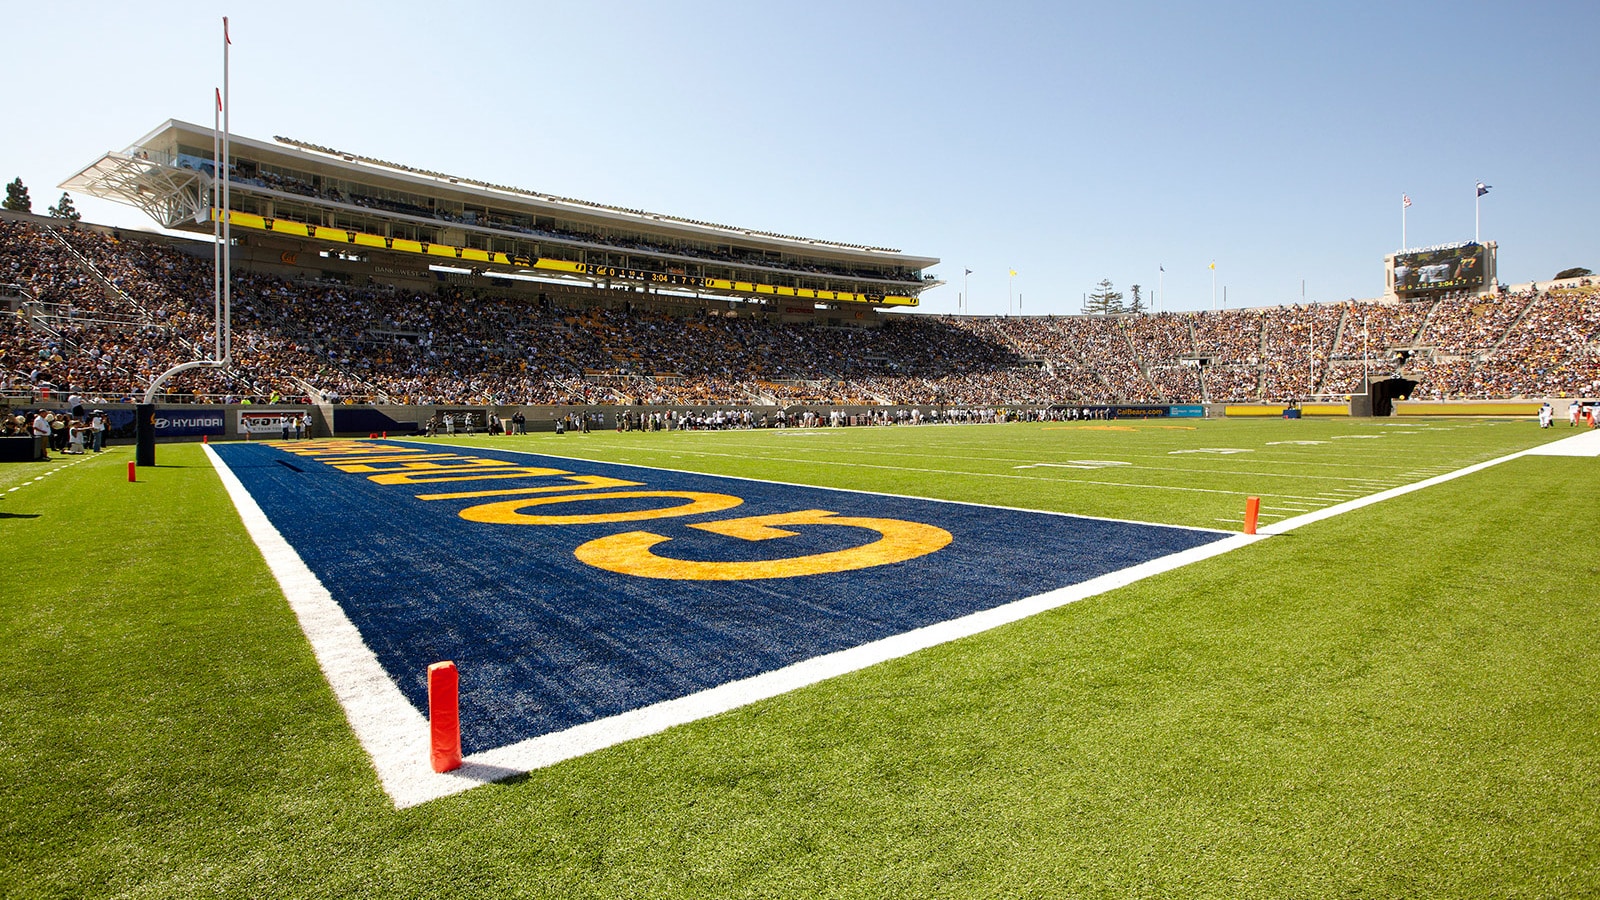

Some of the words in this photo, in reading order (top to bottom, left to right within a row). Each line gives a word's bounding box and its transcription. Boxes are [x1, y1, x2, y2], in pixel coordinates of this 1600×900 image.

[1431, 242, 1460, 251] WEST
[375, 266, 394, 274] BANK
[400, 269, 419, 277] WEST
[609, 268, 615, 277] 0
[652, 273, 668, 282] 3:04
[173, 418, 223, 427] HYUNDAI
[313, 453, 953, 581] GOLDEN
